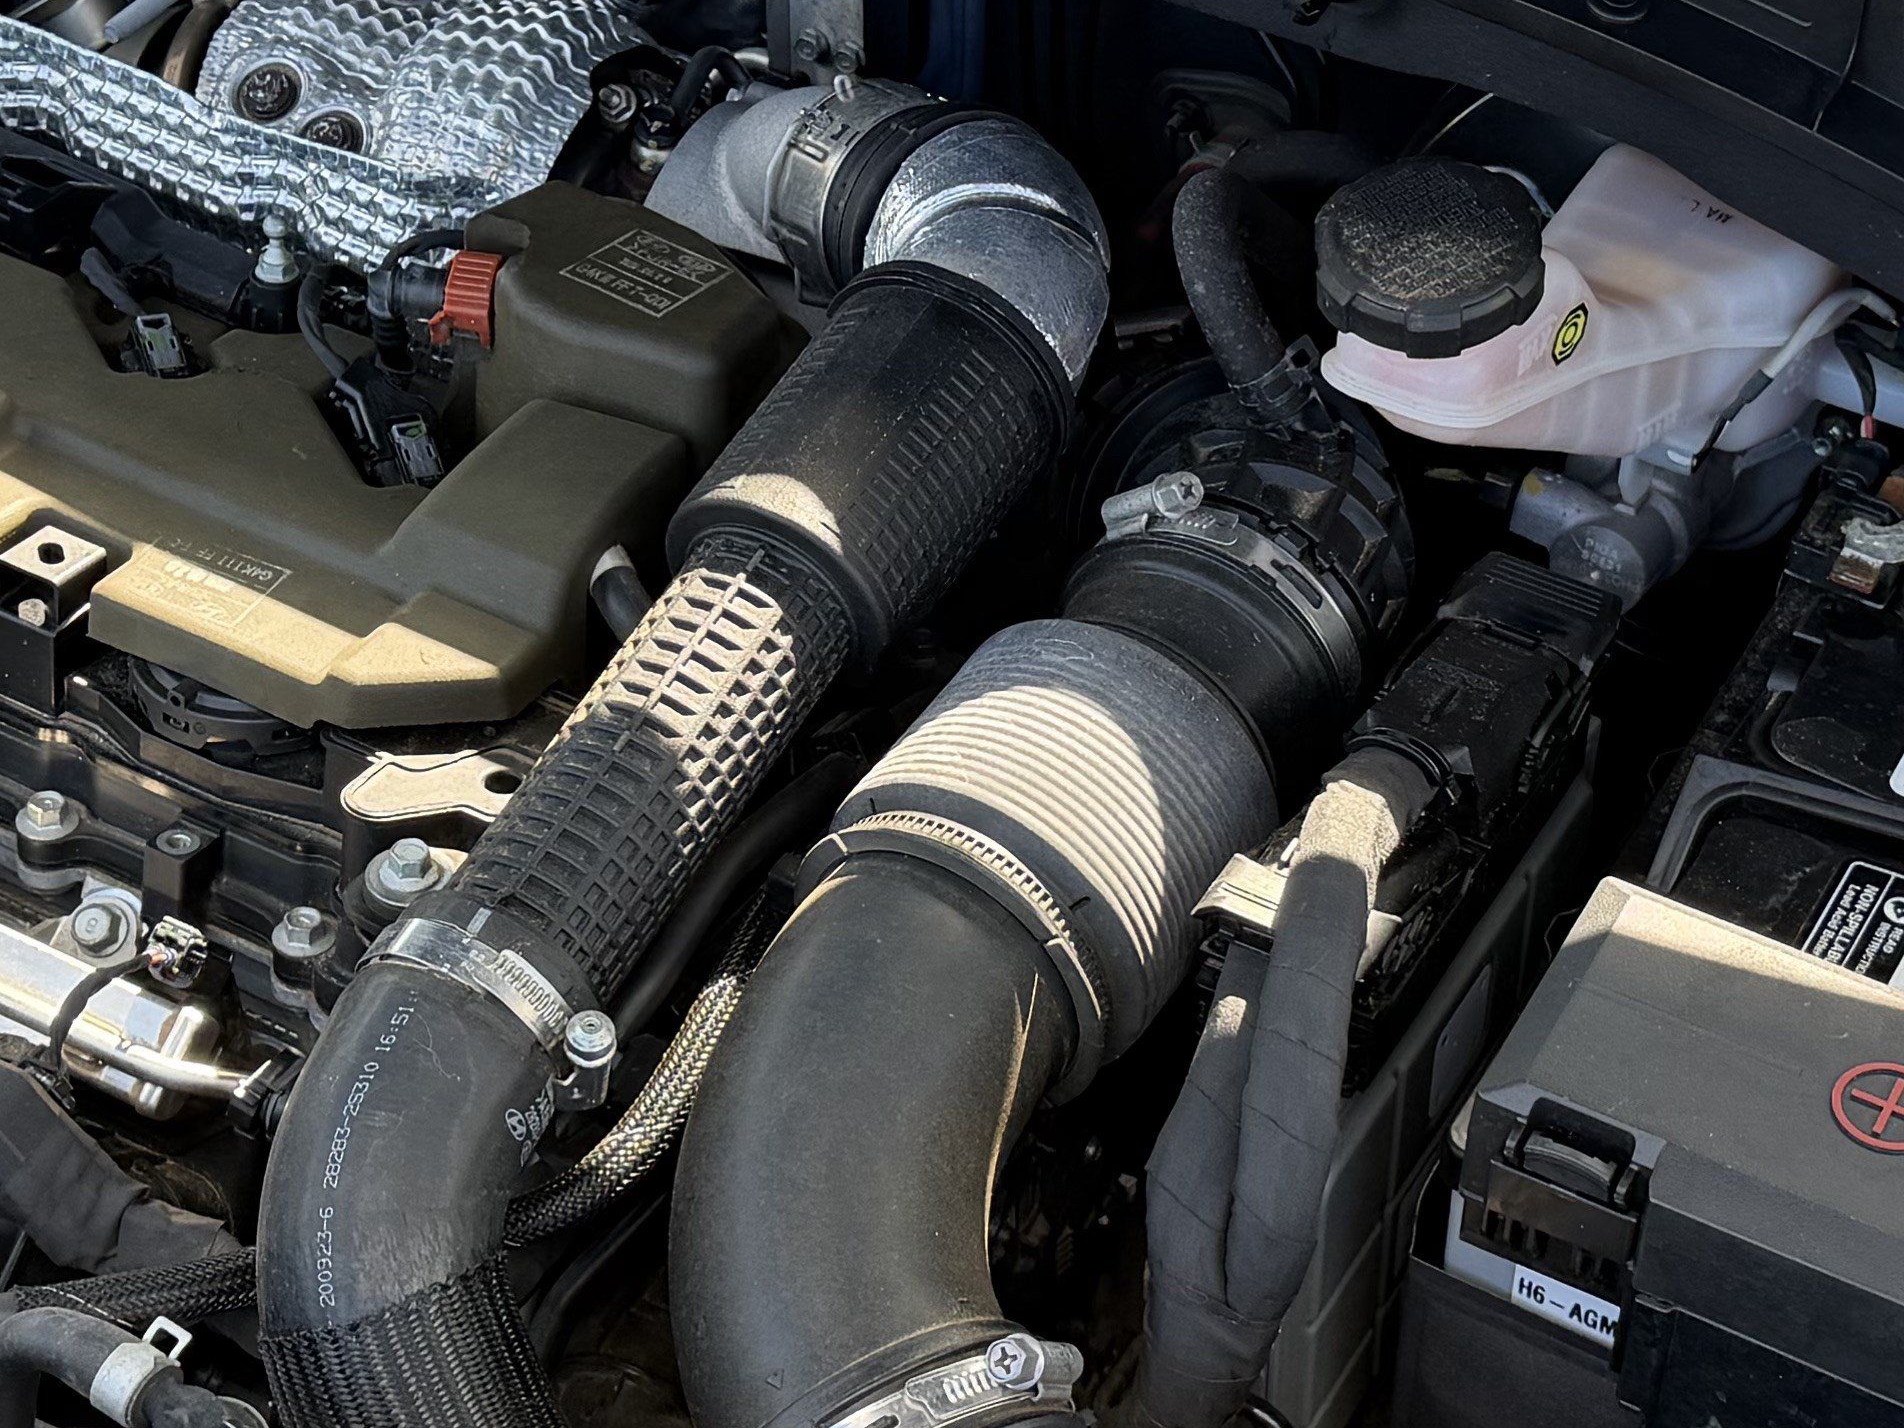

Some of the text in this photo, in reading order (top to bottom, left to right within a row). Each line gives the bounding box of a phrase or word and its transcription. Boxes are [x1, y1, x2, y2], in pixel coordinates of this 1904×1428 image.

[1838, 882, 1861, 908] Lead
[1826, 906, 1847, 929] Acid
[1880, 925, 1904, 954] READ
